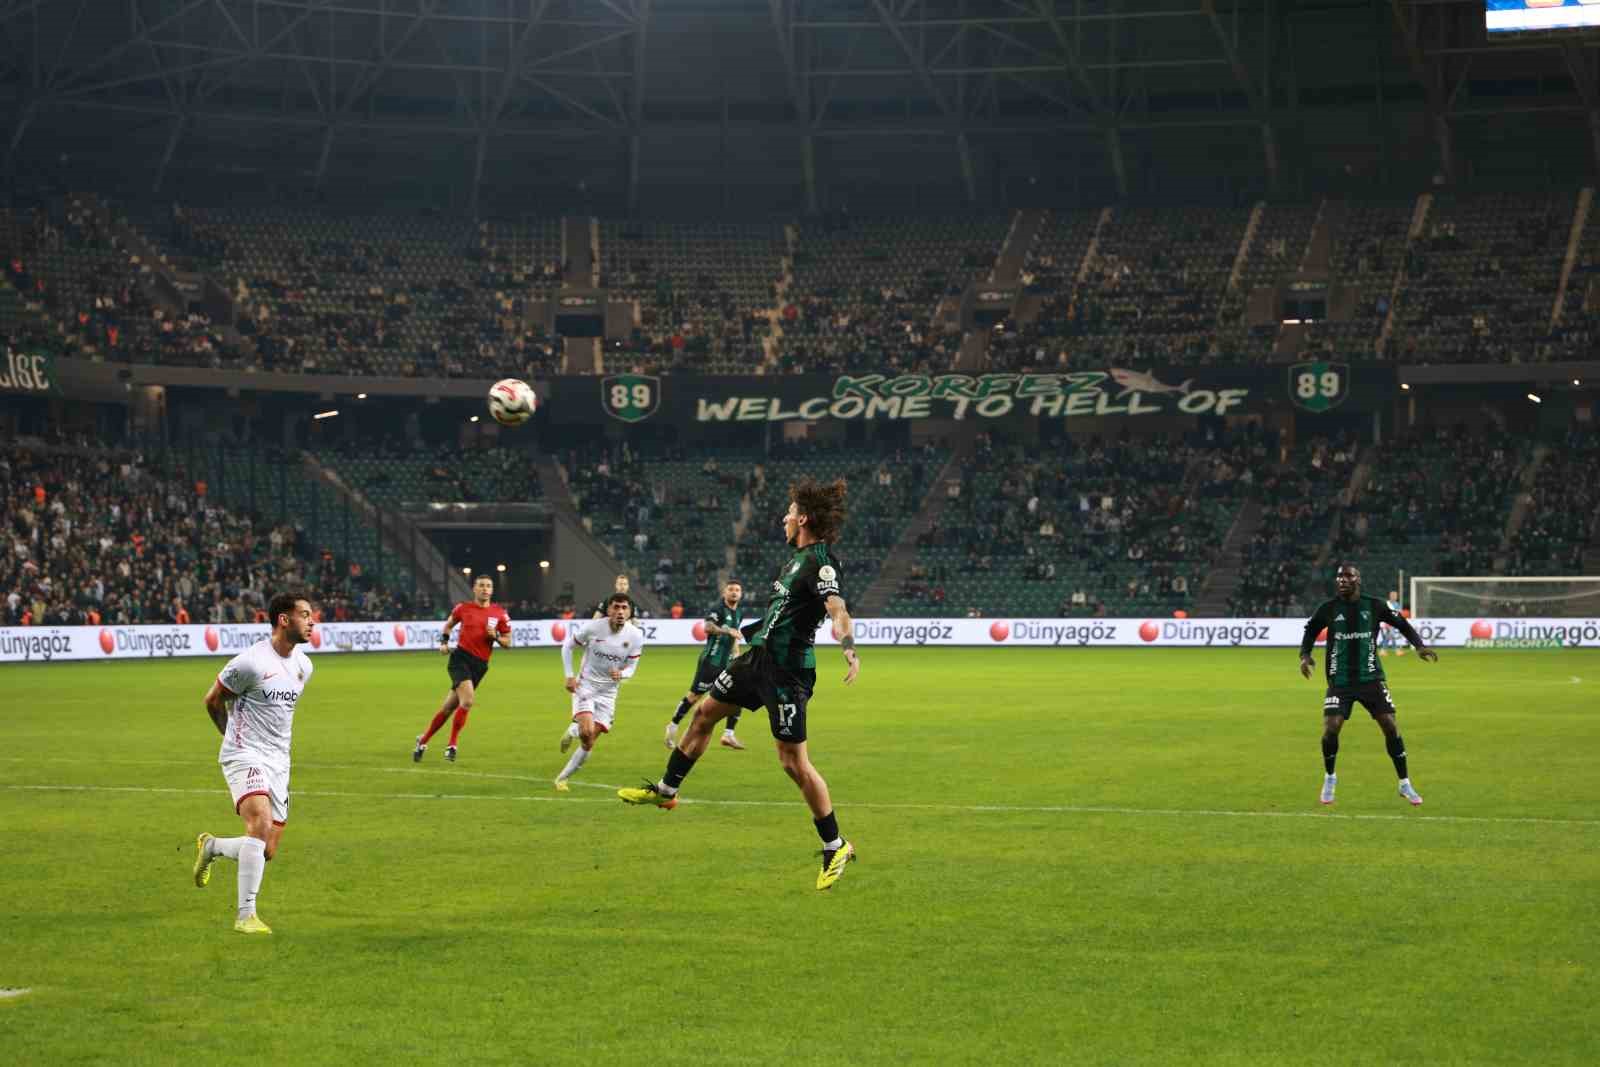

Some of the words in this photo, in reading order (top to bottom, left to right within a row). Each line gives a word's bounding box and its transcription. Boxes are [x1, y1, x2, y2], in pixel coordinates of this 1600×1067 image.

[611, 384, 650, 409] 89
[1297, 371, 1339, 398] 89
[696, 393, 931, 421] WELCOME
[946, 394, 1013, 420] TO
[1030, 391, 1162, 418] HELL
[1178, 388, 1248, 416] OF
[116, 628, 191, 656] Dünyagöz
[854, 622, 953, 645] Dünyagöz
[1013, 622, 1116, 645] Dünyagöz
[1163, 621, 1270, 645] Dünyagöz
[1495, 620, 1600, 646] Dünyagö
[777, 703, 797, 726] 17
